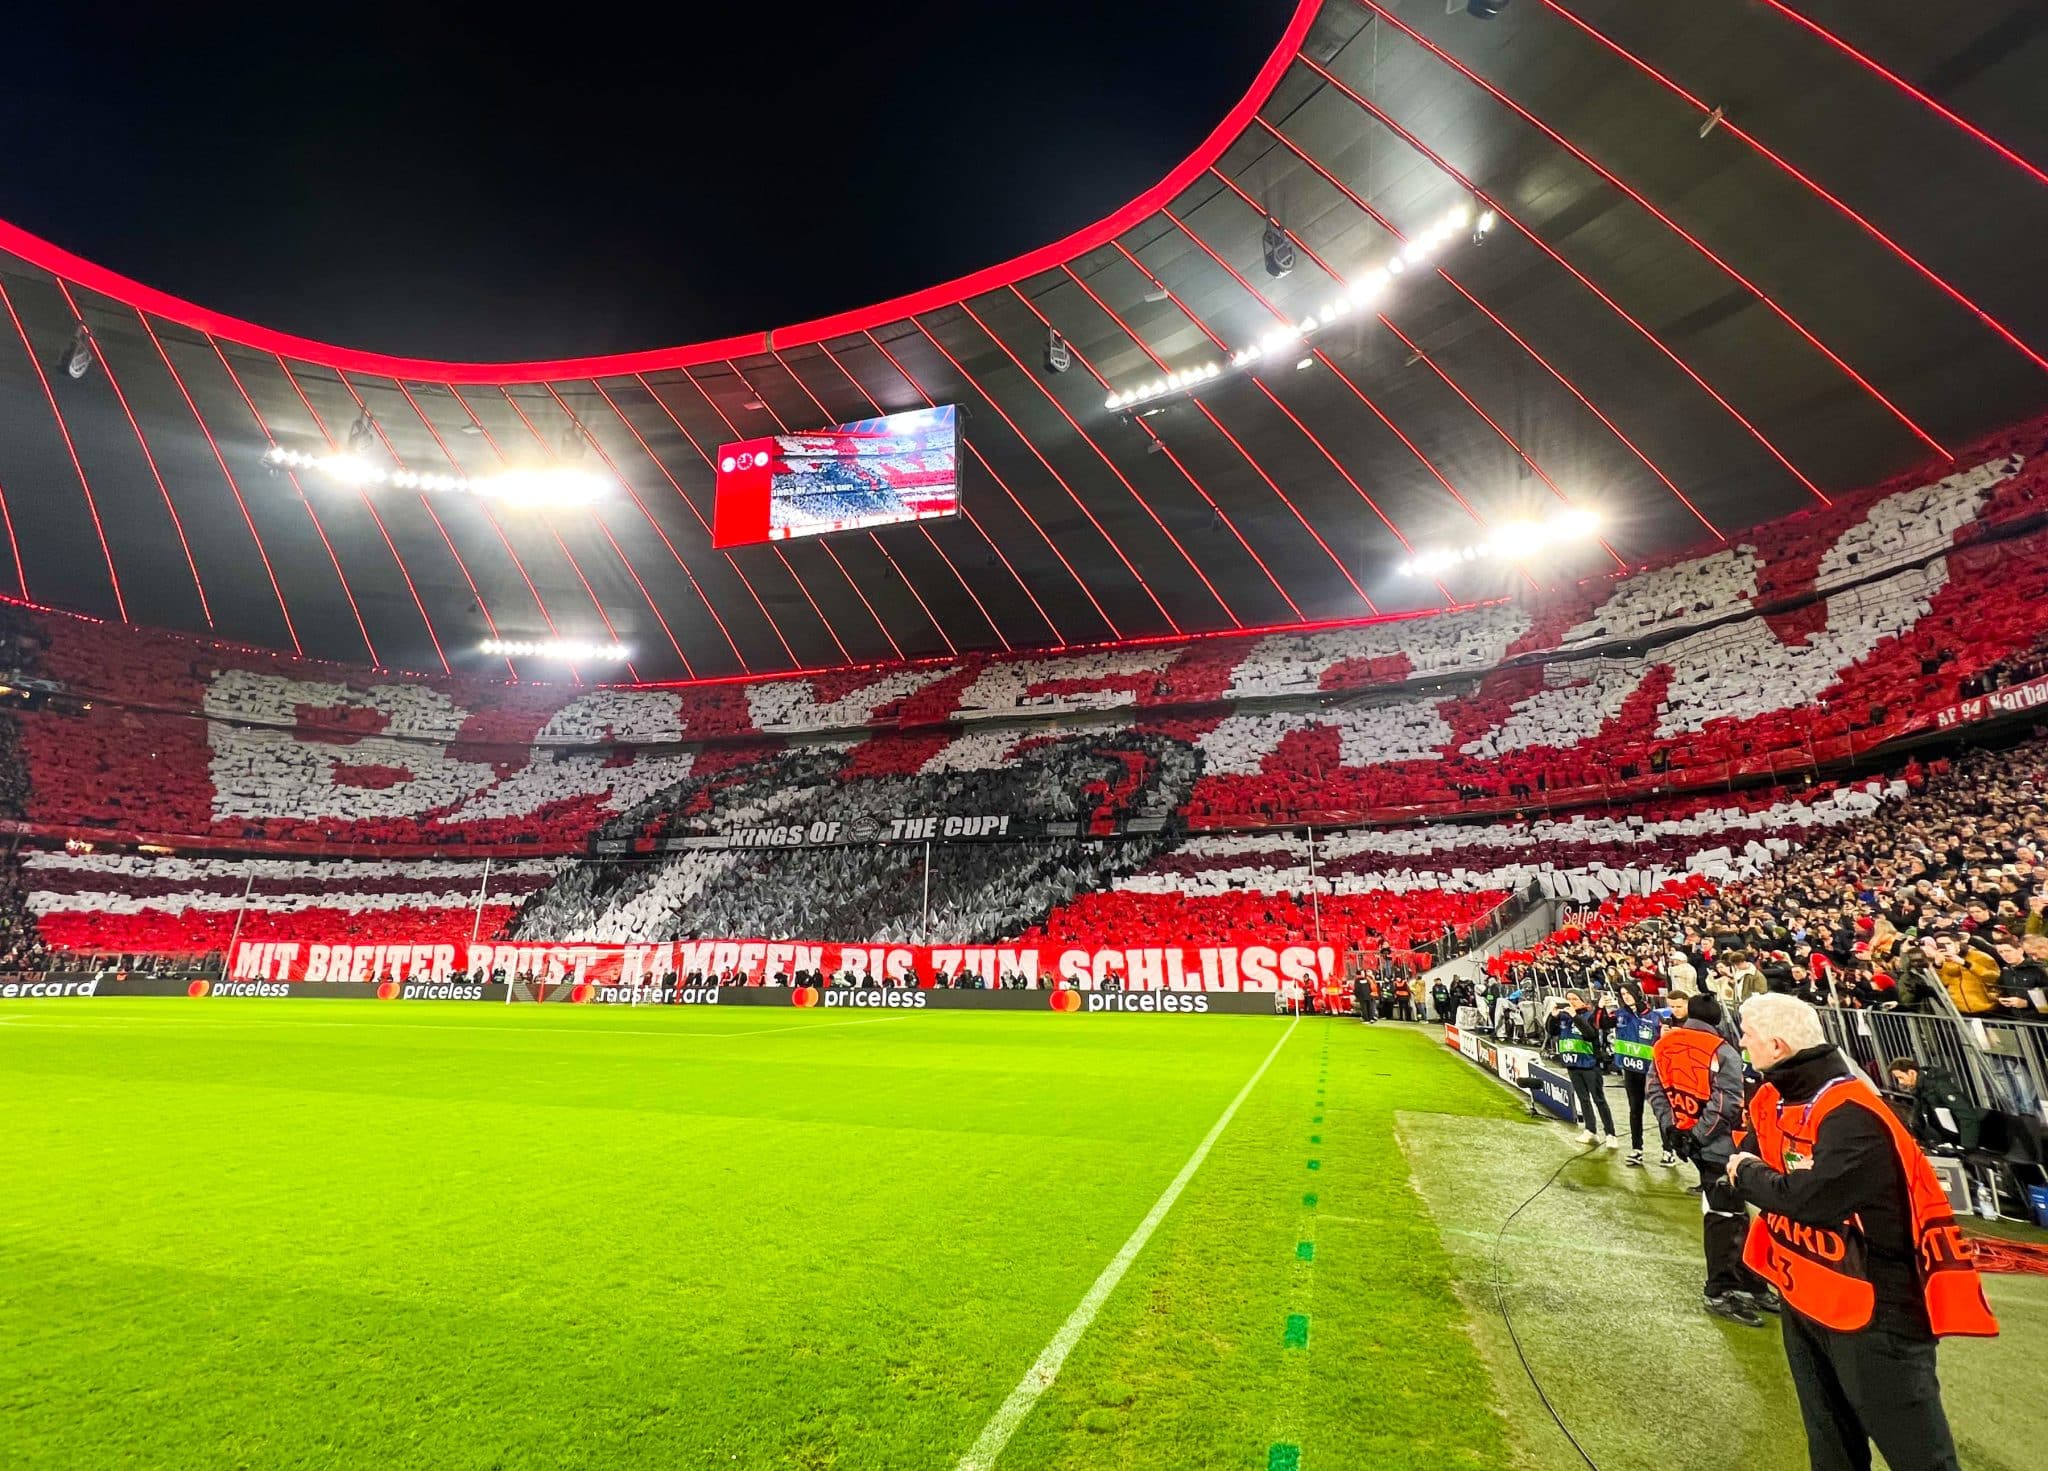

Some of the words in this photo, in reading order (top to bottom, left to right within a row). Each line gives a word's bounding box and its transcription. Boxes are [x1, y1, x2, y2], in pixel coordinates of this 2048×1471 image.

[1961, 700, 1981, 718] 94
[729, 825, 804, 847] KINGS
[809, 821, 840, 843] OF
[891, 817, 937, 840] THE
[944, 815, 1009, 837] CUP!
[233, 942, 300, 979] MIT
[304, 944, 456, 984] BREITER
[840, 948, 913, 989] BIS
[932, 949, 1040, 989] ZUM
[1059, 946, 1335, 993] SCHLUSS!
[211, 981, 289, 997] priceless
[403, 982, 481, 1000] priceless
[825, 987, 926, 1007] priceless
[1089, 990, 1208, 1012] priceless
[1624, 1043, 1641, 1054] TV
[1562, 1053, 1578, 1063] 047
[1623, 1057, 1644, 1070] 048
